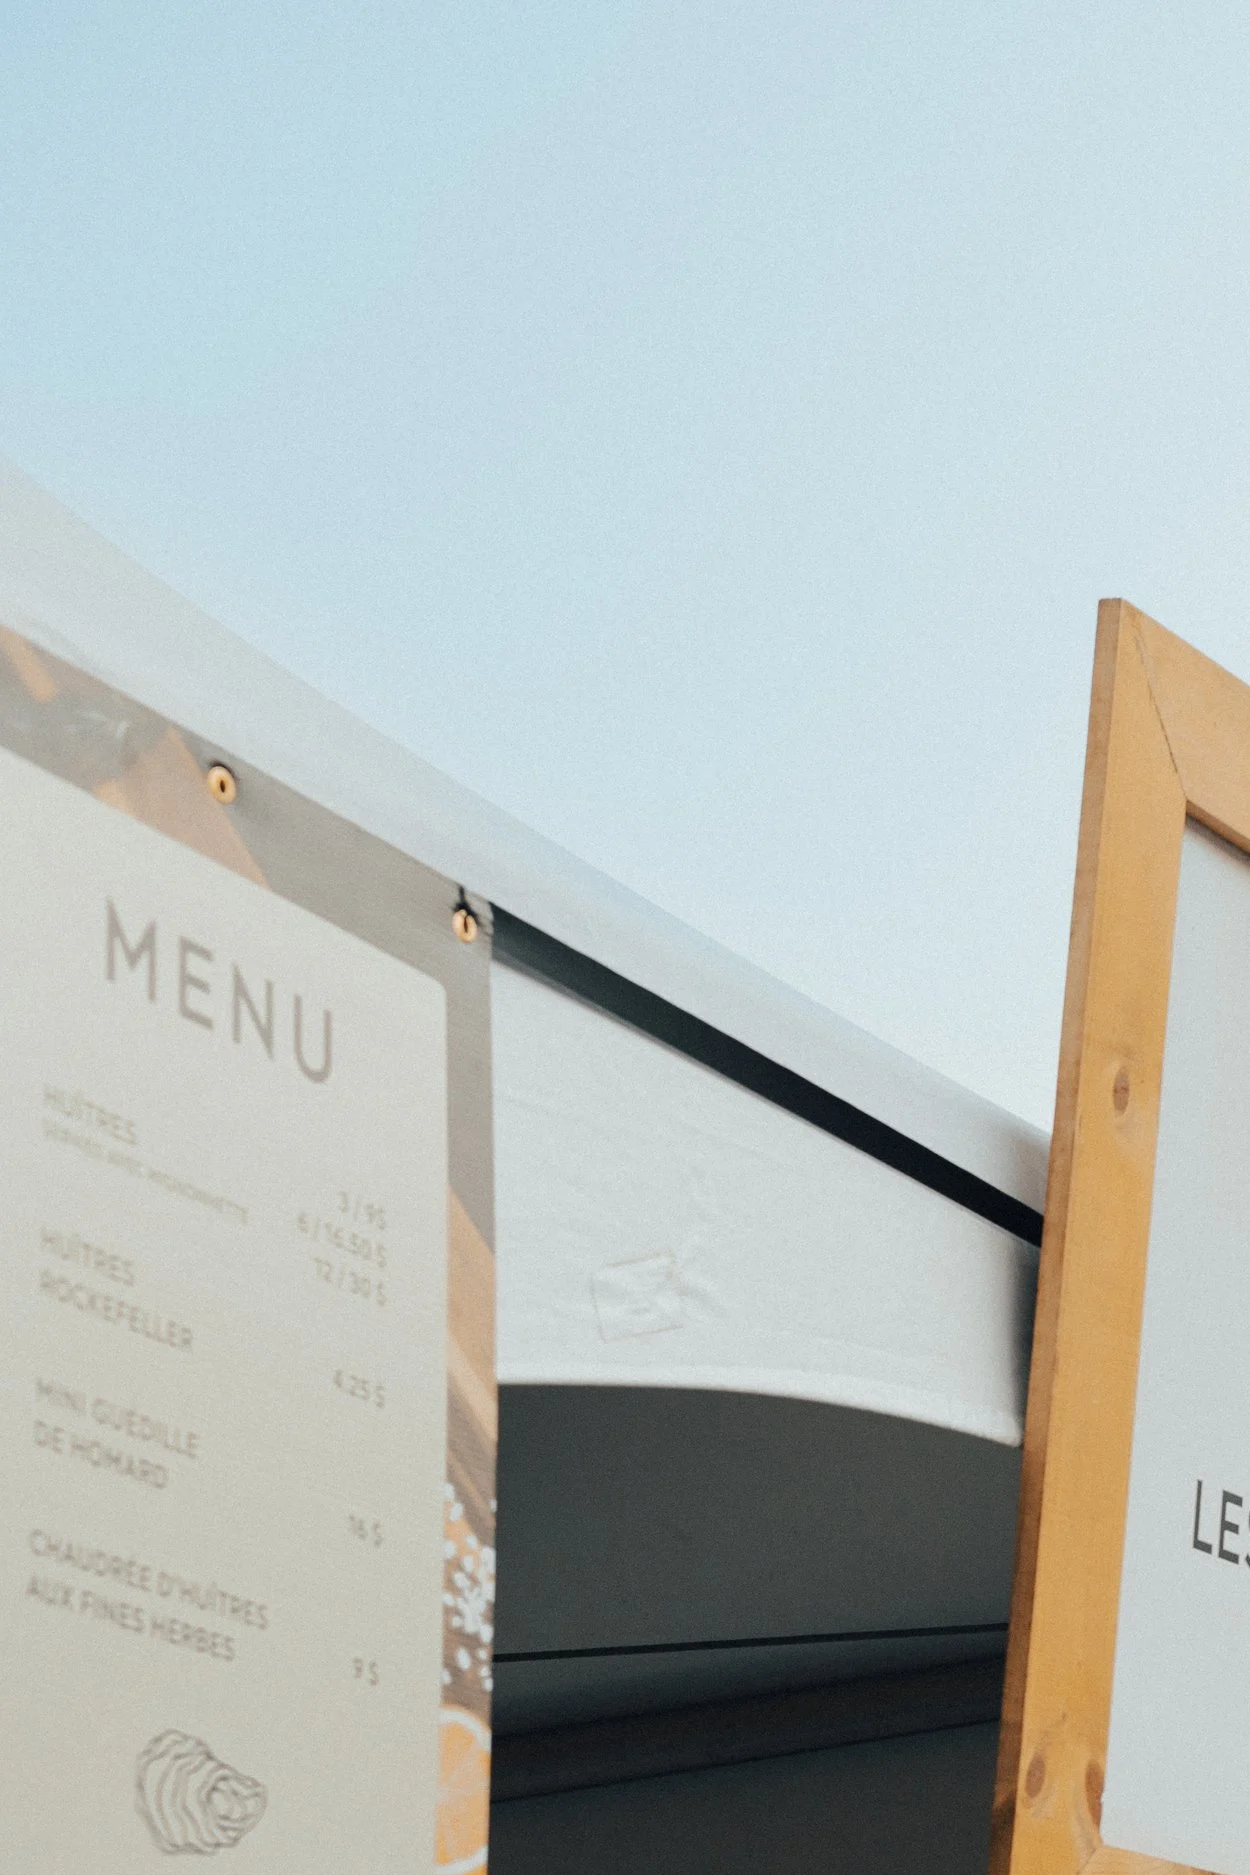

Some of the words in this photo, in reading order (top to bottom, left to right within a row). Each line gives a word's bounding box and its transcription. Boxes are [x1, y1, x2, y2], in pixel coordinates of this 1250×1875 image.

[103, 895, 333, 1084] MENU
[34, 1418, 64, 1455] DE
[70, 1433, 170, 1490] HOMARD
[27, 1574, 74, 1612] AUX
[80, 1588, 145, 1635] FINES
[151, 1614, 237, 1663] HERBES
